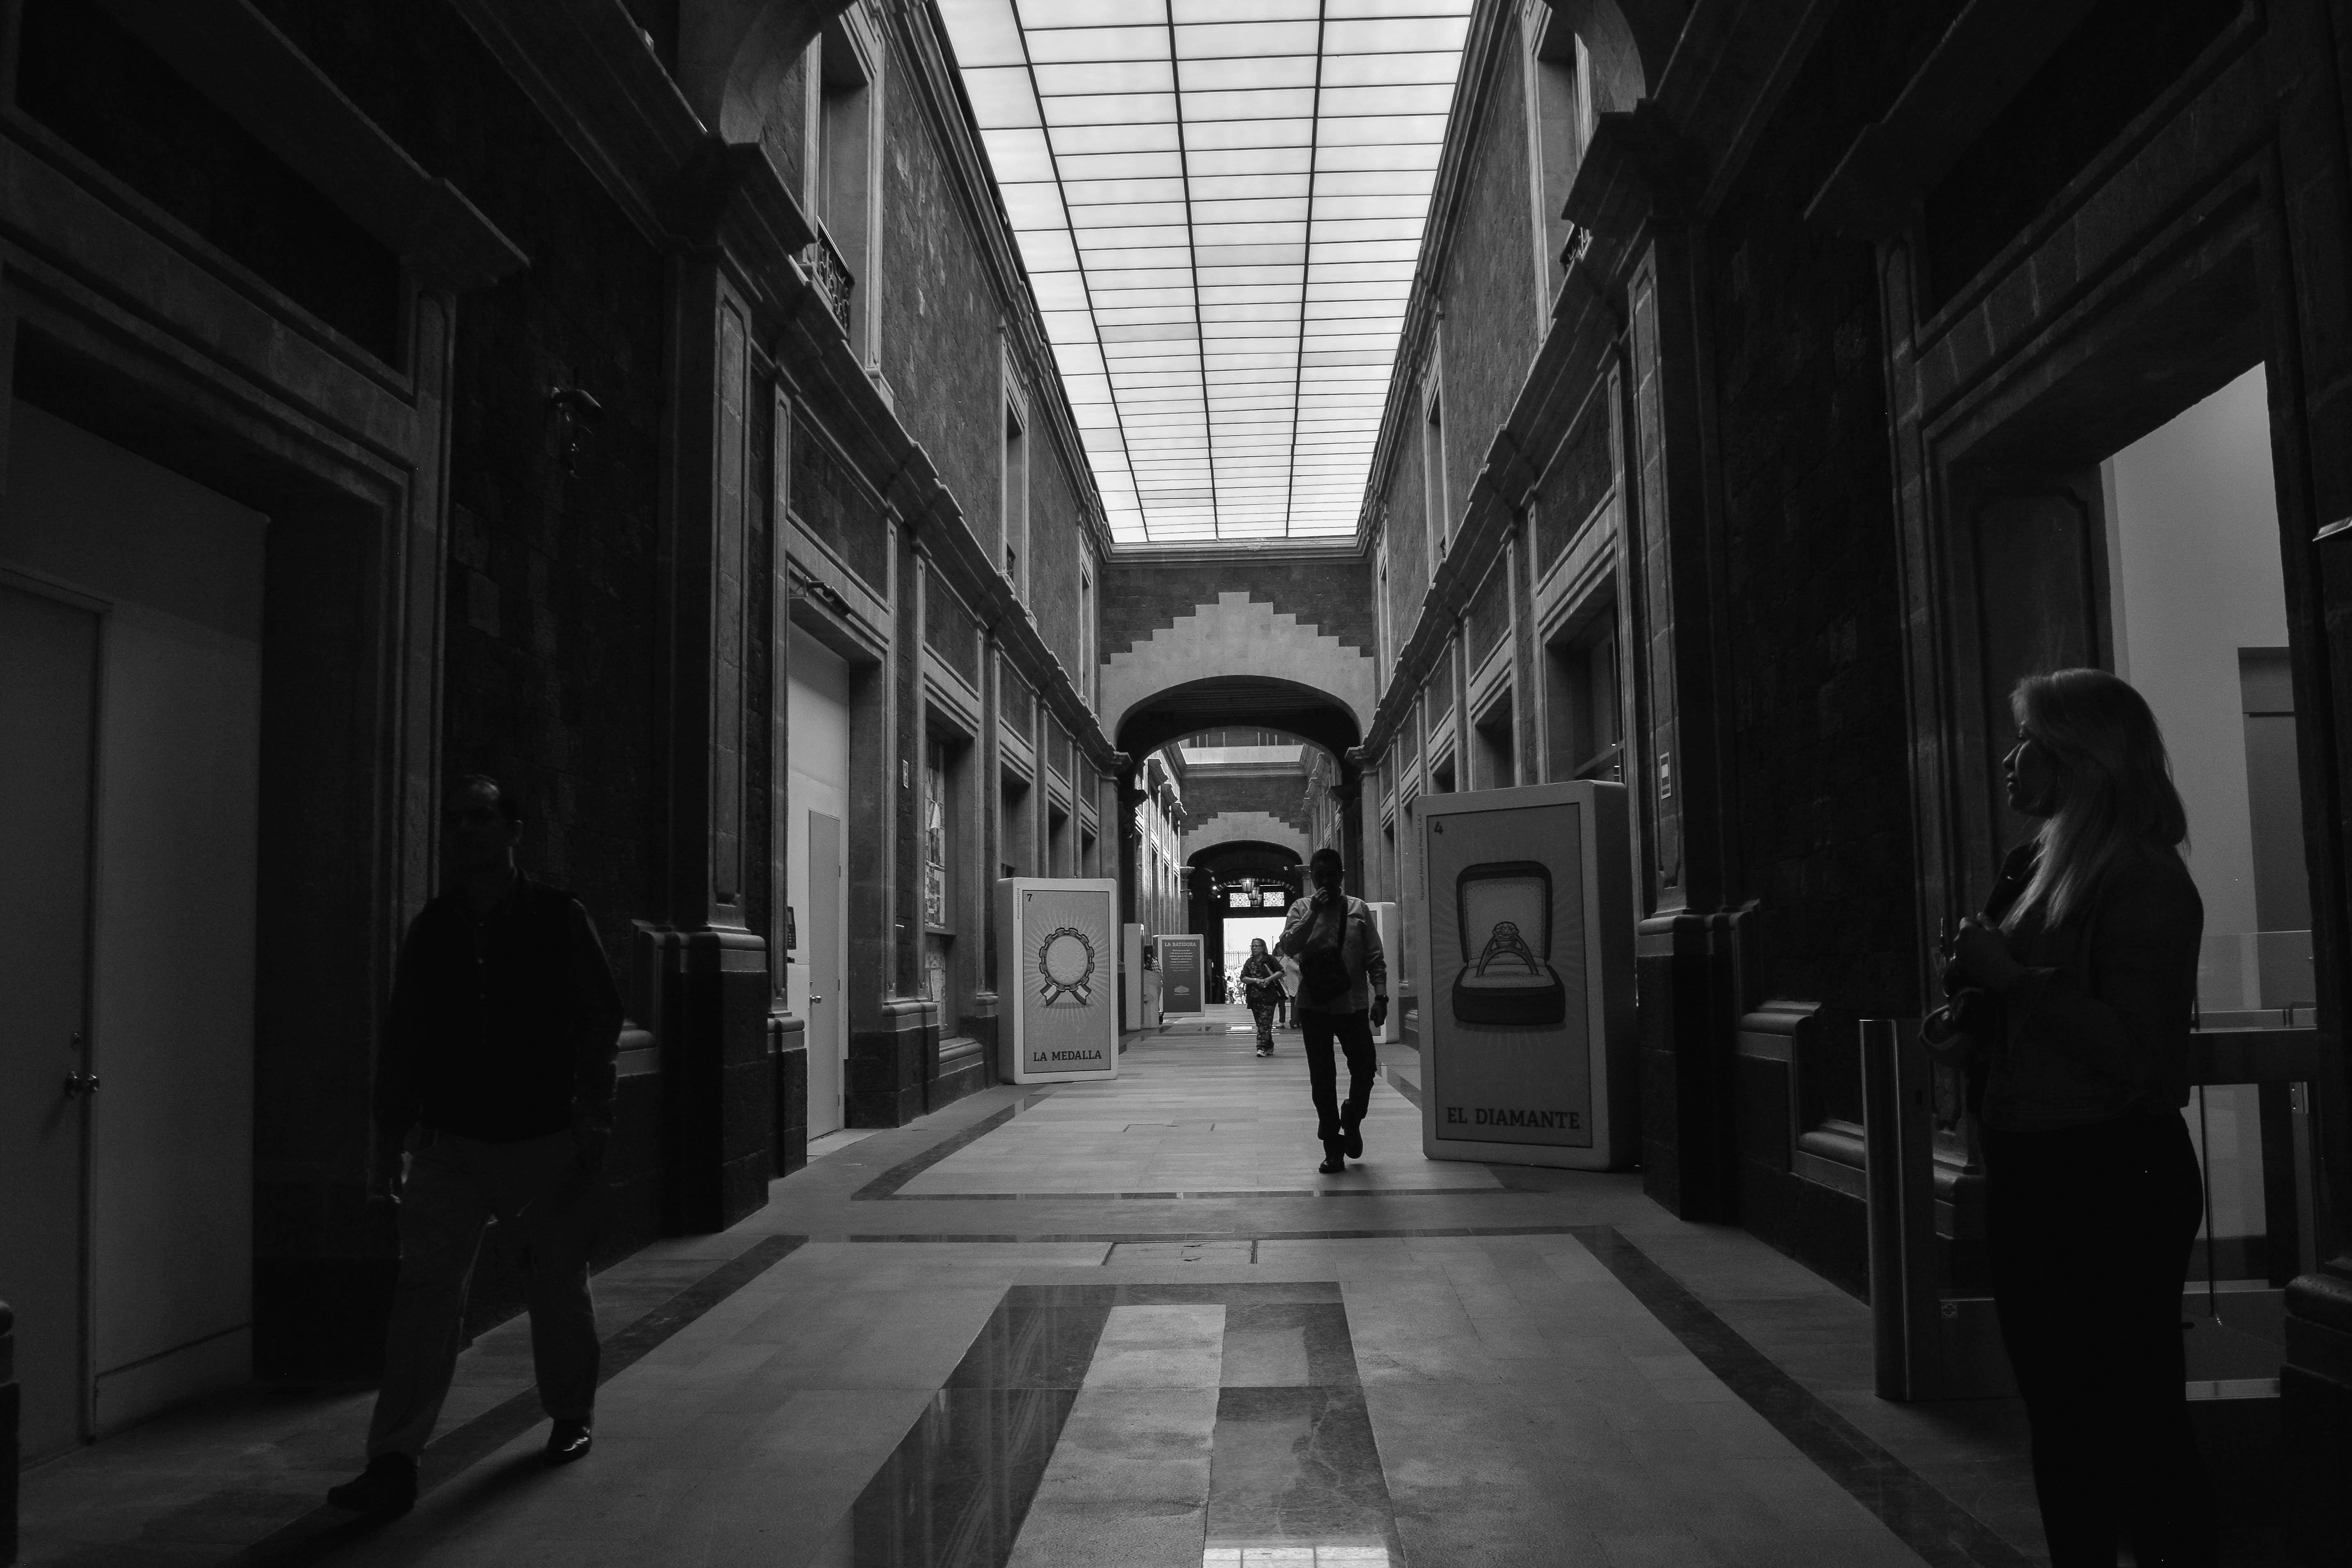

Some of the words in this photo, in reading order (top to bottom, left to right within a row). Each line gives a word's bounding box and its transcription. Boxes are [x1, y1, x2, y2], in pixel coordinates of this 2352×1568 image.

[1434, 821, 1443, 834] 4
[1027, 894, 1033, 902] 7
[1033, 1052, 1047, 1062] LA
[1051, 1050, 1102, 1061] MEDALLA
[1447, 1107, 1468, 1124] EL
[1475, 1108, 1580, 1129] DIAMANTE
